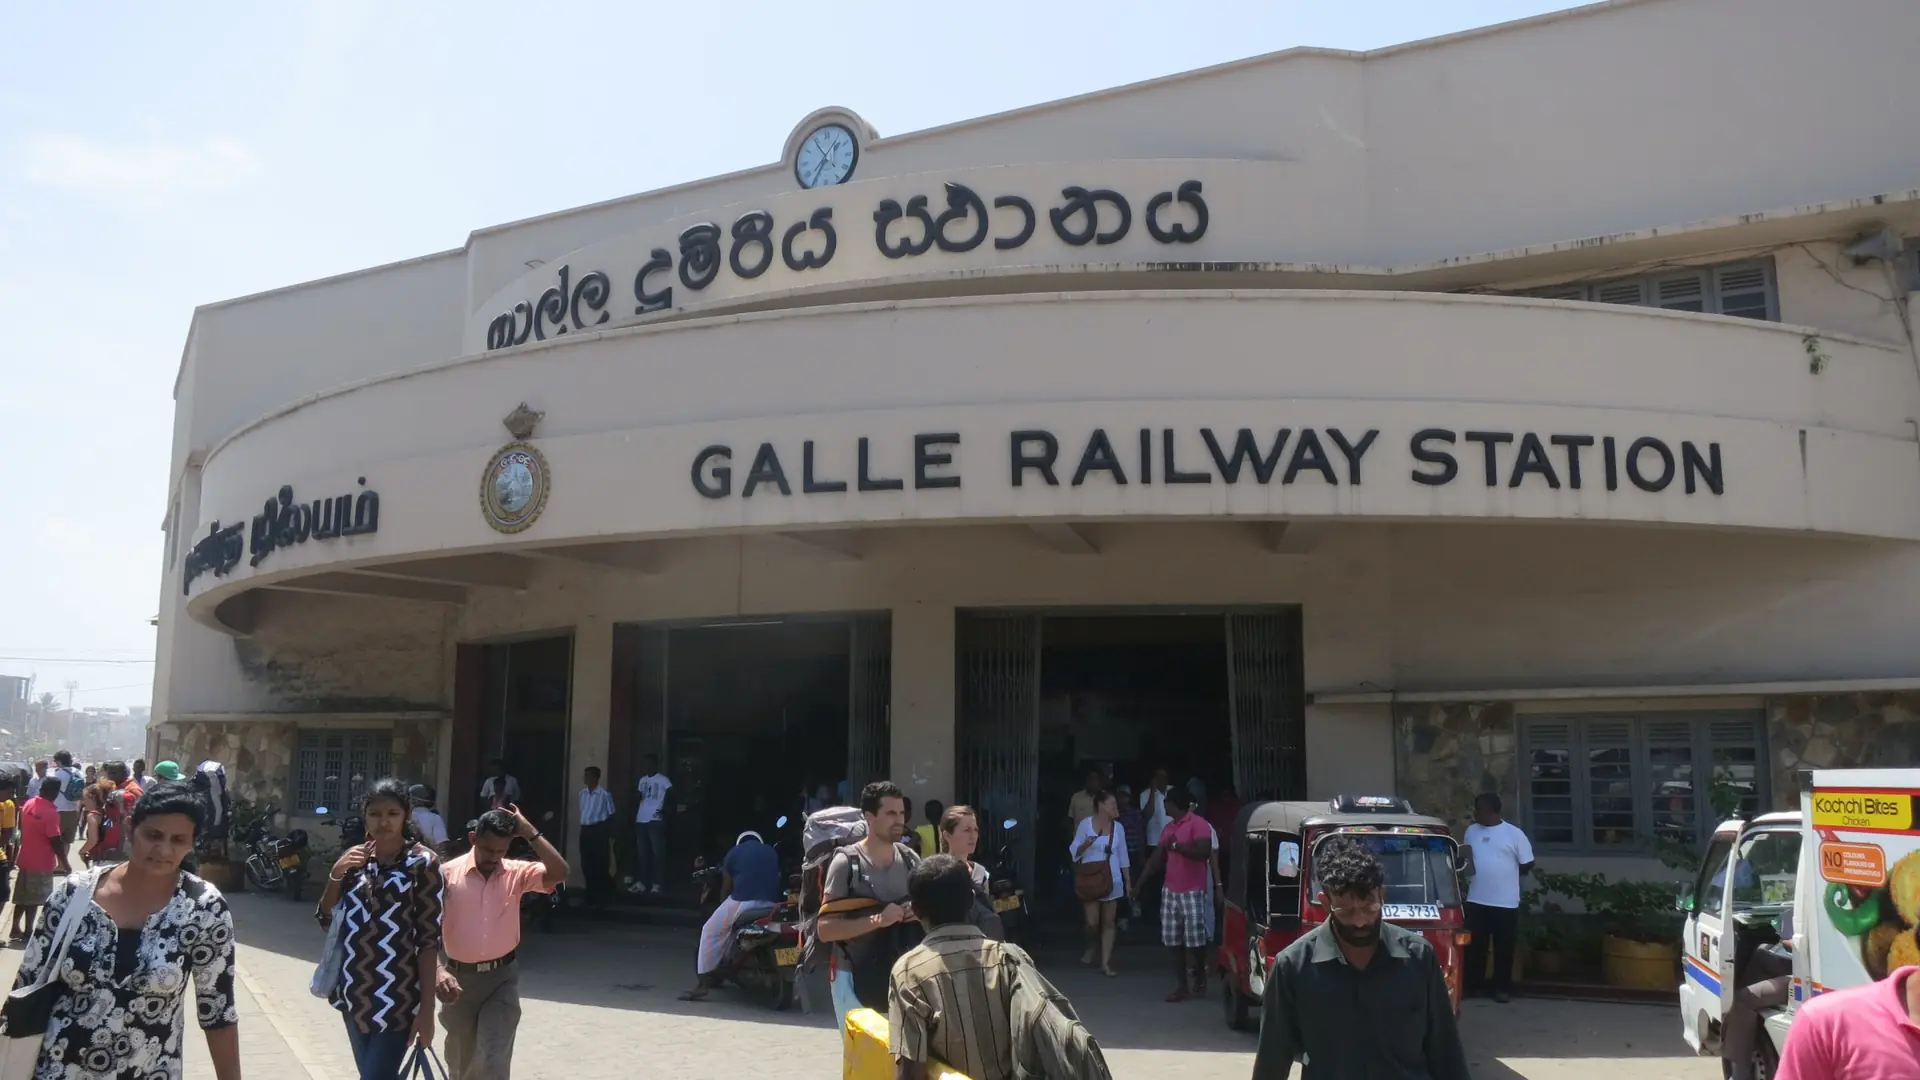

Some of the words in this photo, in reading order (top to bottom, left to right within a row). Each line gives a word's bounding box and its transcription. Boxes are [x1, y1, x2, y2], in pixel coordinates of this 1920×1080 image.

[691, 433, 960, 498] GALLE
[1010, 429, 1380, 486] RAILWAY
[1410, 428, 1724, 495] STATION
[1815, 797, 1862, 814] Kochchi
[1864, 798, 1898, 816] Bites
[1843, 816, 1871, 827] Chicken
[1824, 851, 1842, 867] NO
[1382, 905, 1438, 917] 02-3731
